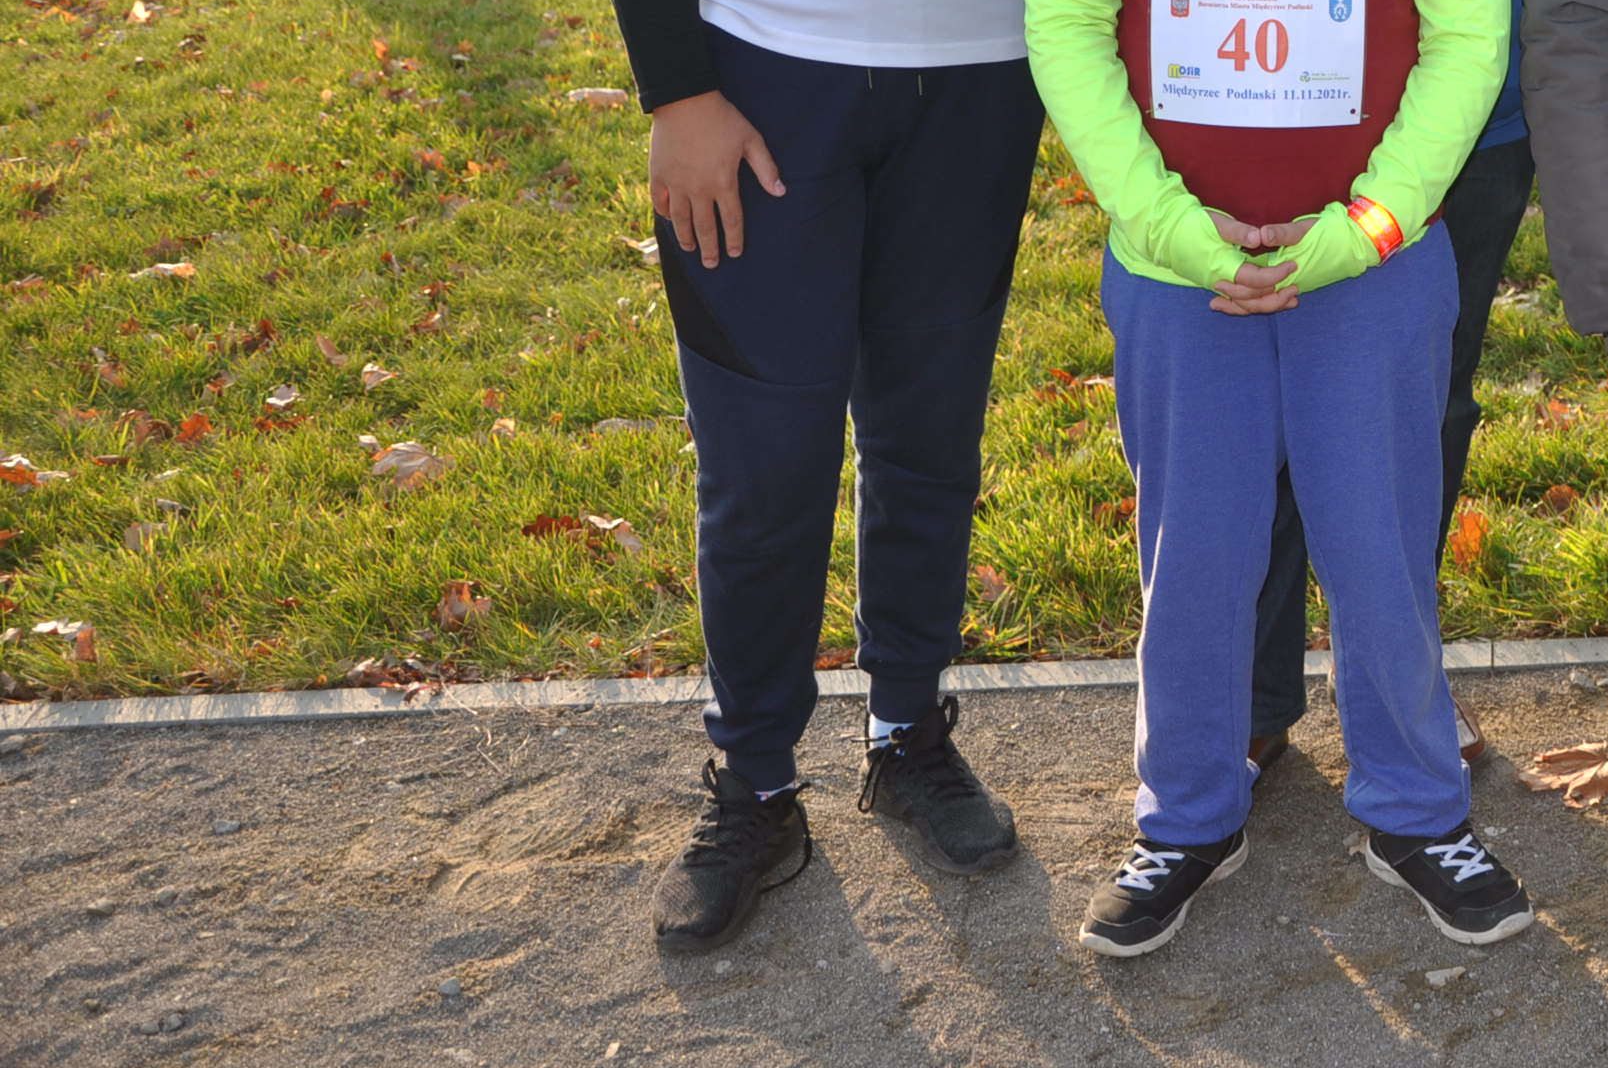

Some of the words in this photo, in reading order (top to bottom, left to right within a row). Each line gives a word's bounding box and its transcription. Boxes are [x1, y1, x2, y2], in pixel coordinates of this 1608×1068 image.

[1217, 18, 1289, 73] 40
[1162, 83, 1220, 98] Międzyrzec
[1226, 88, 1276, 100] Podlaski
[1283, 89, 1351, 100] 11.11.2021r.
